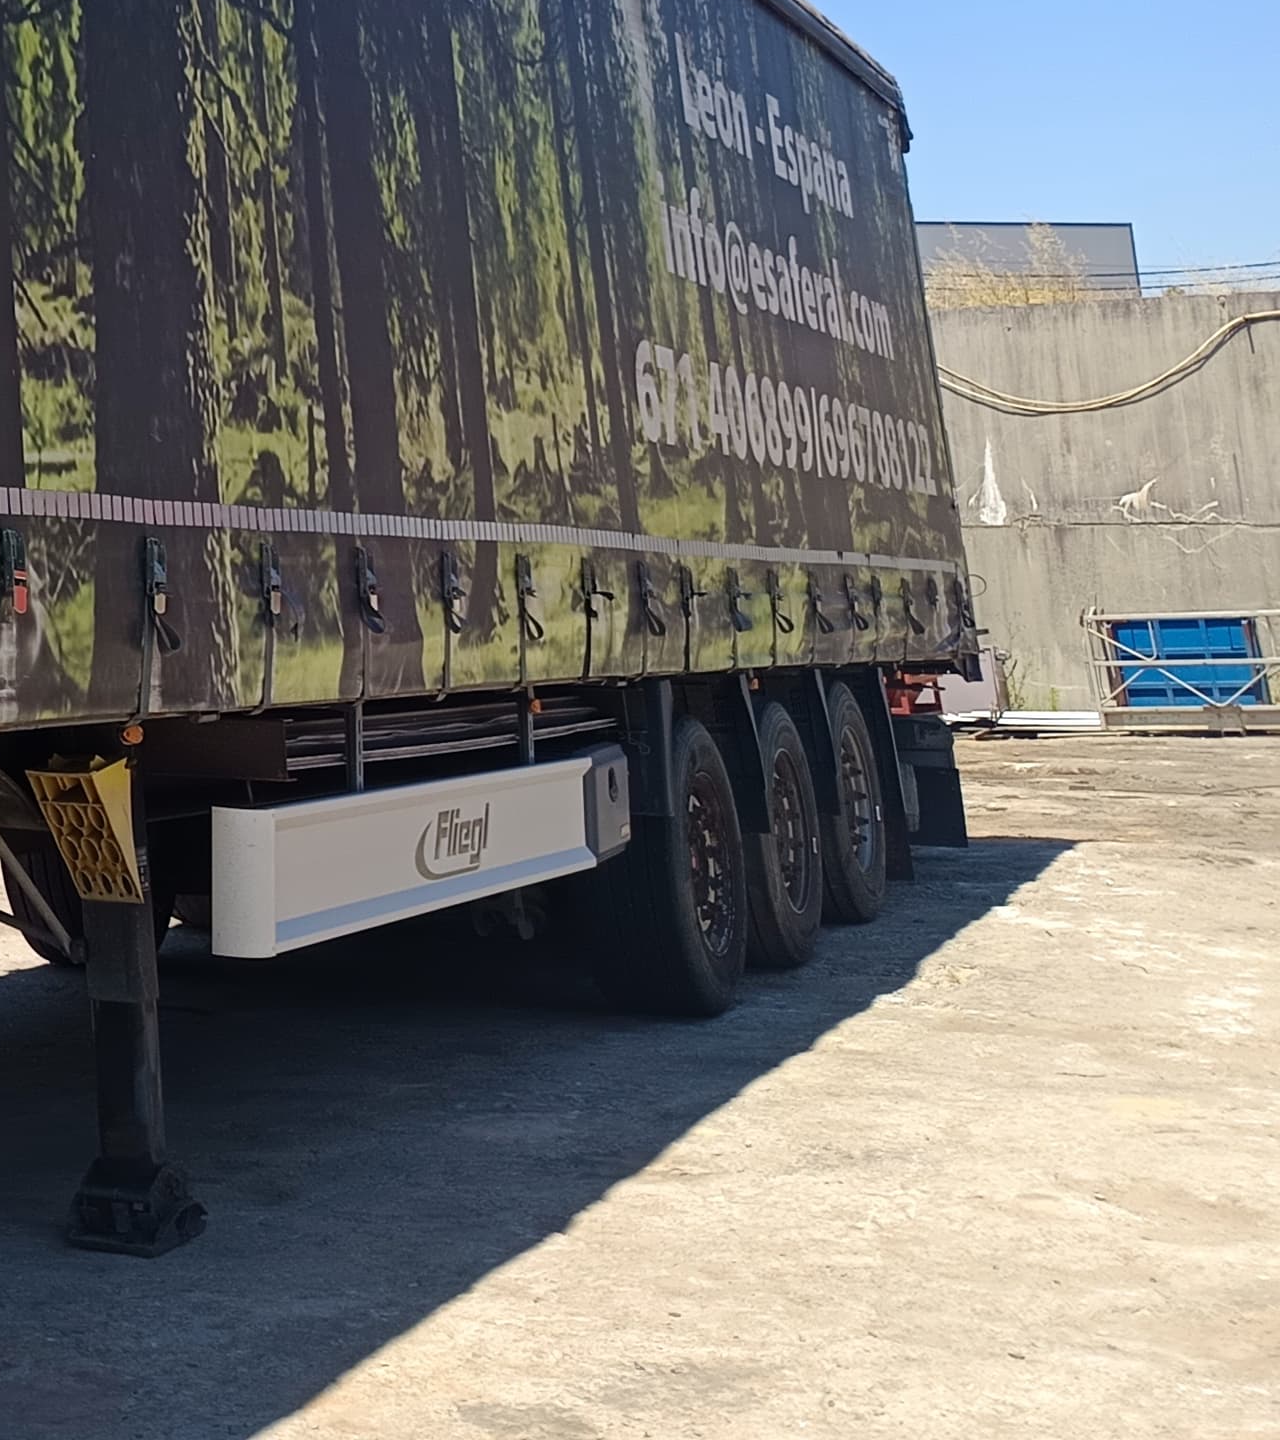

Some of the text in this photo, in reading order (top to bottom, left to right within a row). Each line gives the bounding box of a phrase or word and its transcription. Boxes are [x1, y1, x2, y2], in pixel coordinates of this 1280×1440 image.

[674, 31, 753, 161] León
[765, 93, 854, 220] España
[656, 170, 895, 361] info@esaferal.com
[634, 339, 702, 450] 671
[433, 801, 490, 865] Fliegl
